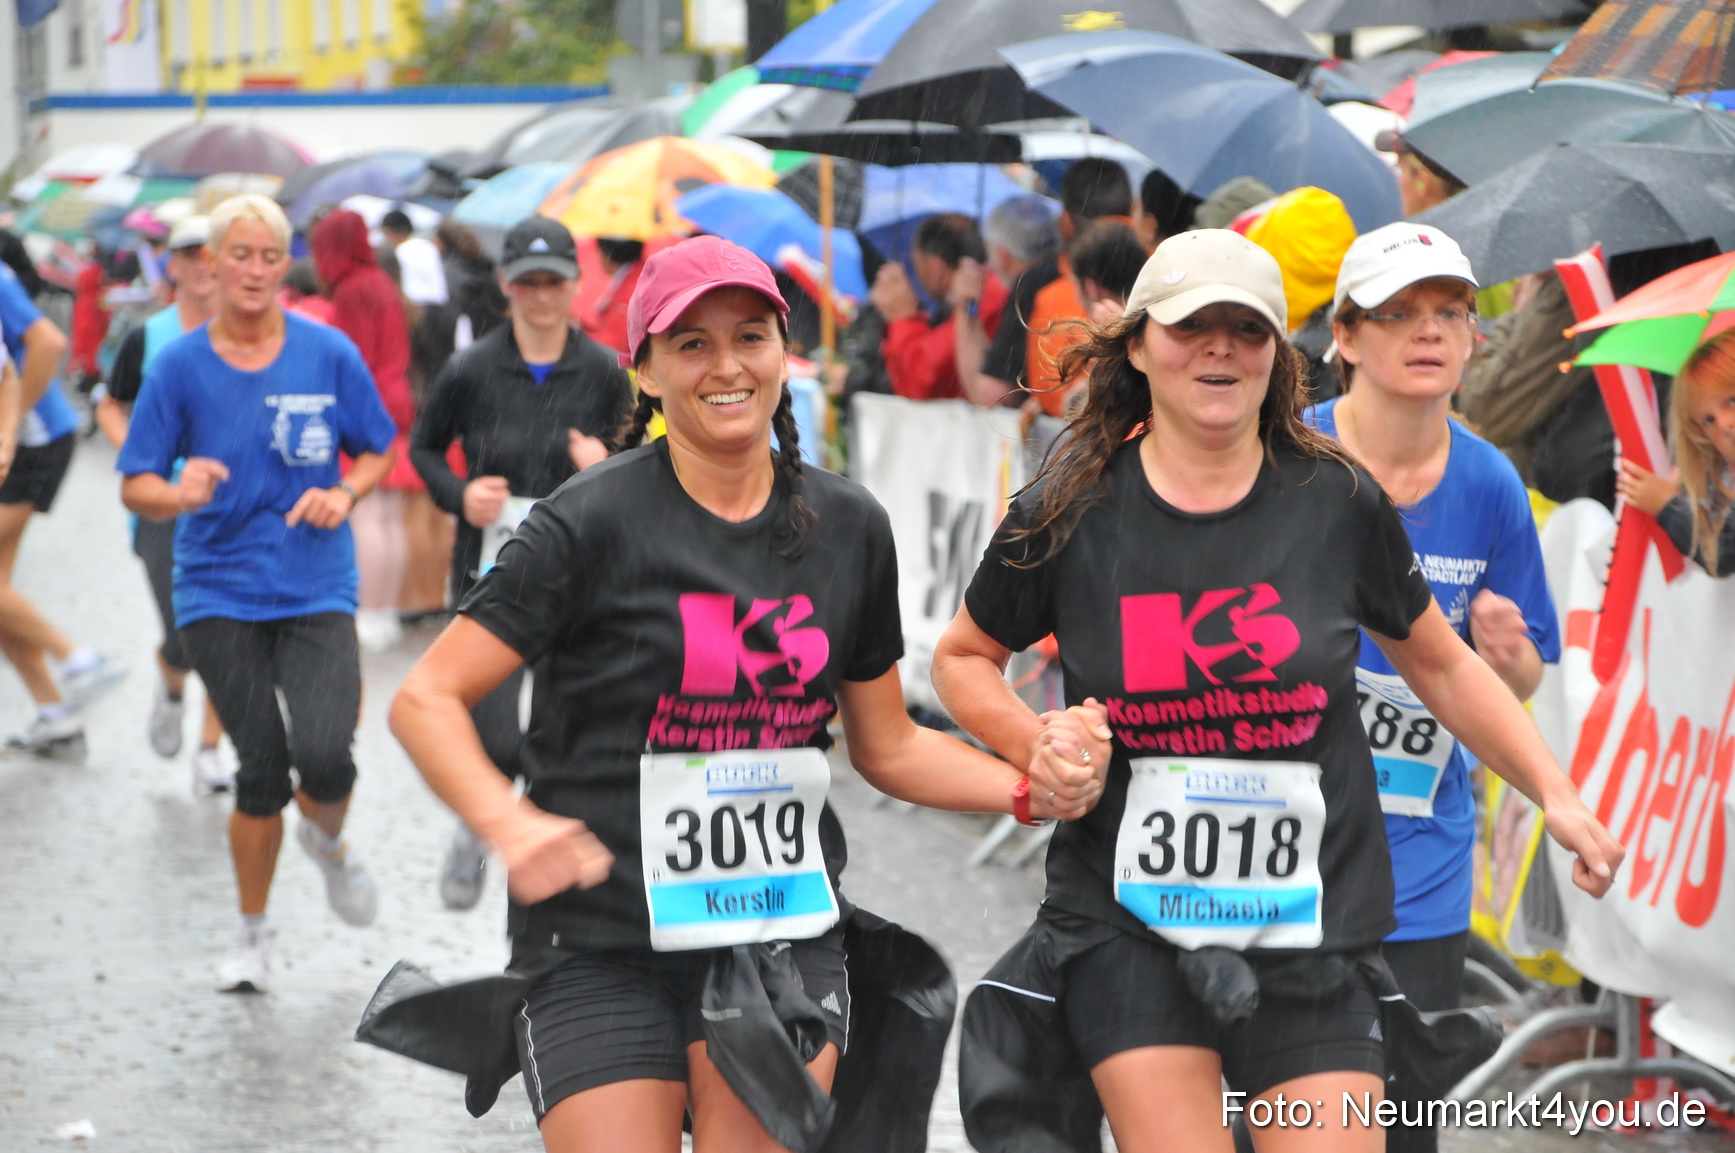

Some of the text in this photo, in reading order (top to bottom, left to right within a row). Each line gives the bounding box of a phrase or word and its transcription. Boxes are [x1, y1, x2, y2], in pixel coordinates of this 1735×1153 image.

[1116, 723, 1226, 755] Kerstin
[664, 801, 806, 872] 3019
[1137, 811, 1302, 879] 3018
[704, 884, 786, 917] Kerstin
[1159, 891, 1280, 921] Michaela
